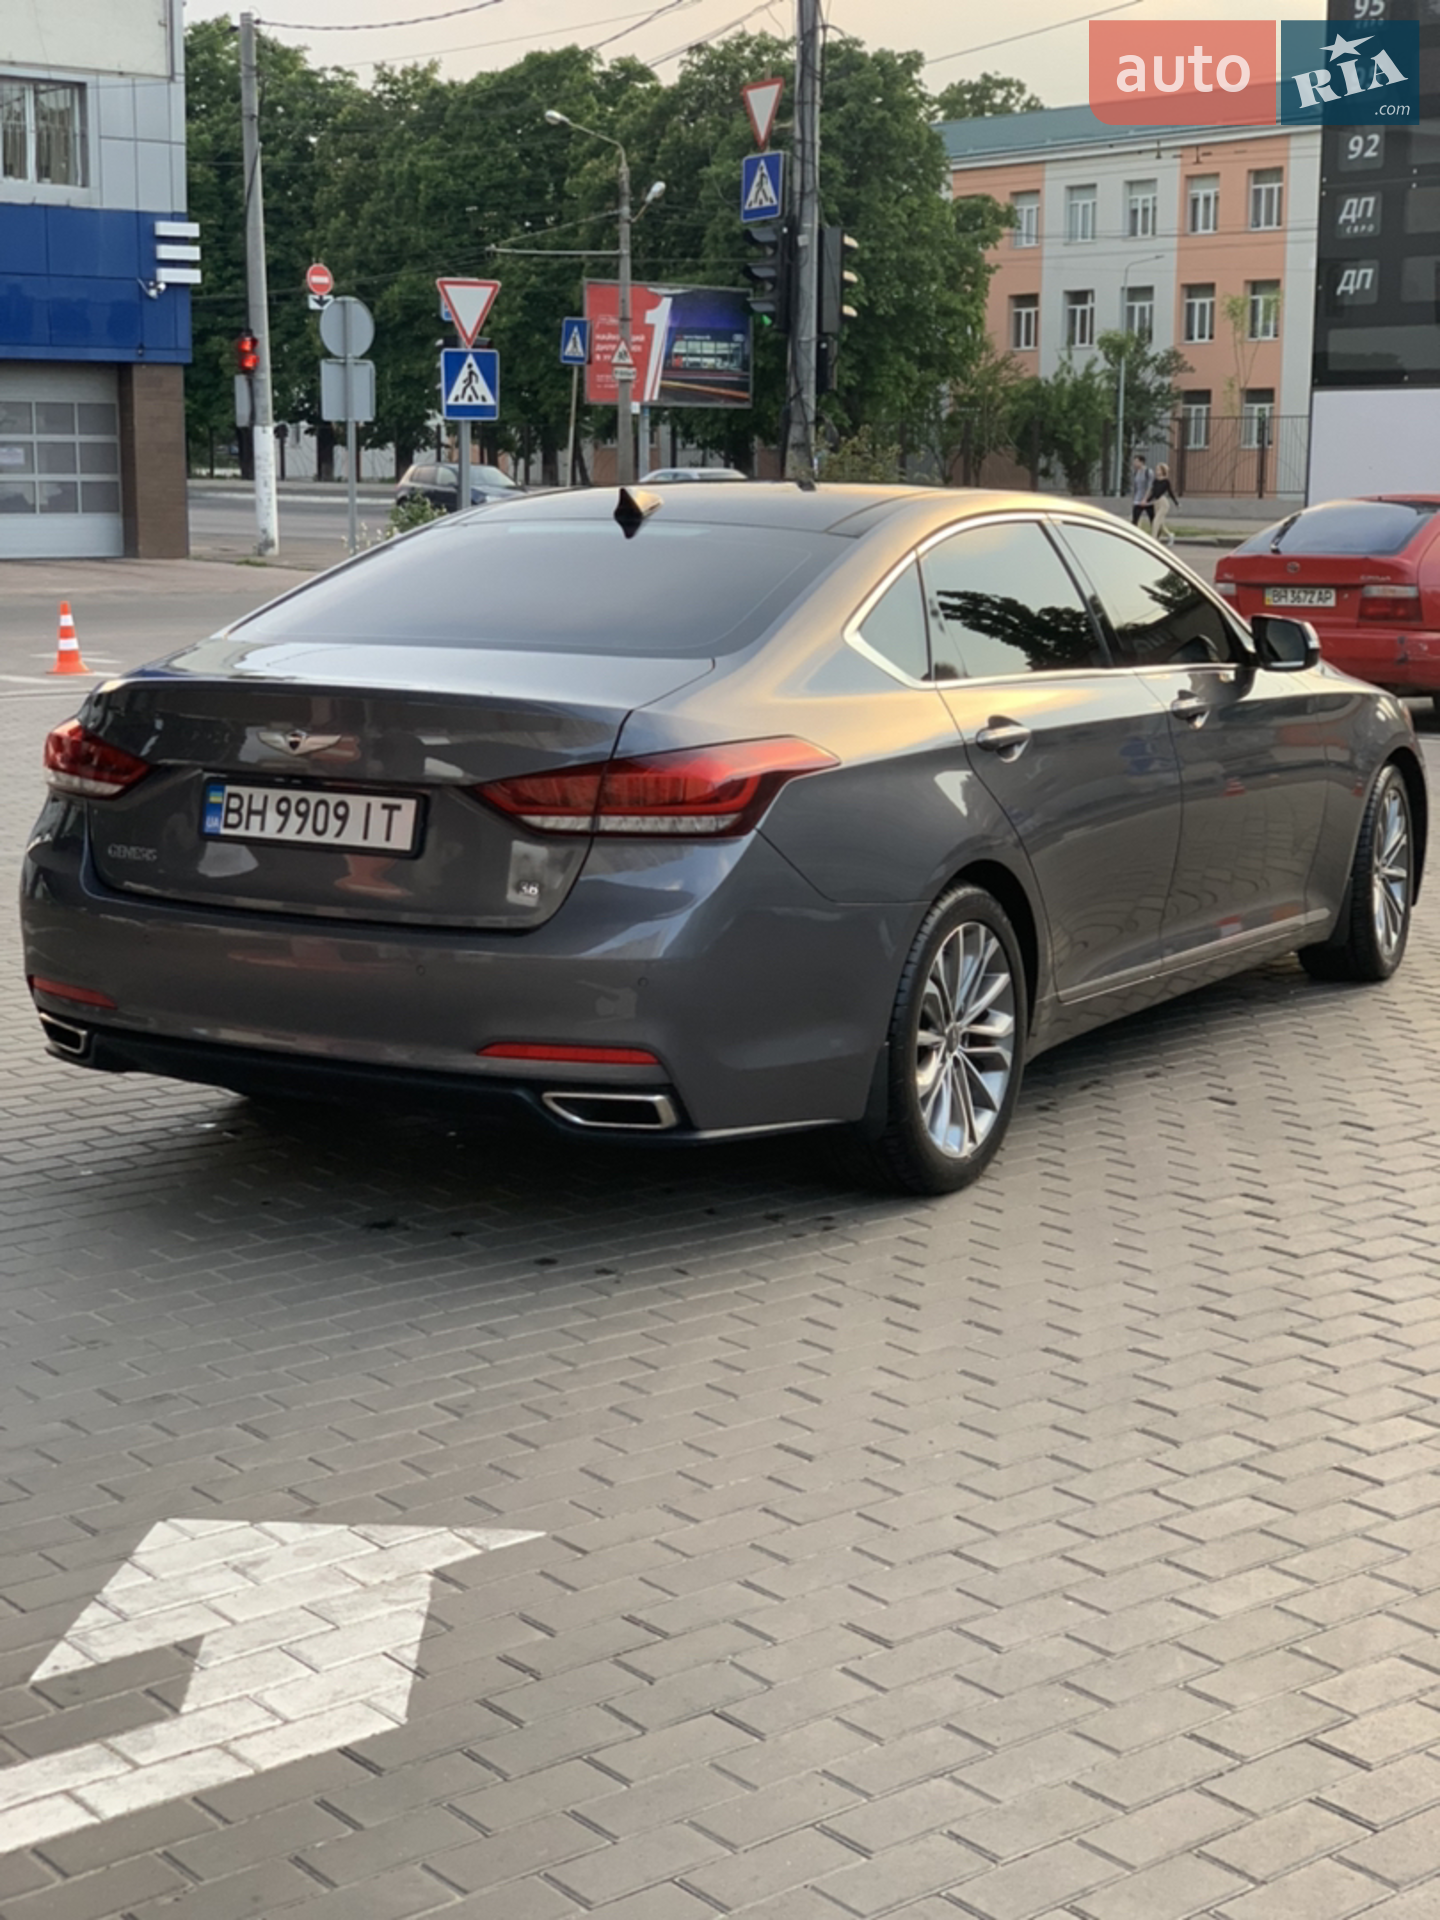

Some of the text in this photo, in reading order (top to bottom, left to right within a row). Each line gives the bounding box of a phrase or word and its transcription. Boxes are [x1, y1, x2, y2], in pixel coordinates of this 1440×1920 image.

[1353, 0, 1385, 19] 95
[1348, 133, 1380, 160] 92
[1338, 196, 1376, 225] ДП
[1336, 268, 1374, 296] ДП
[205, 815, 220, 829] UA
[222, 792, 403, 843] BH 9909 IT
